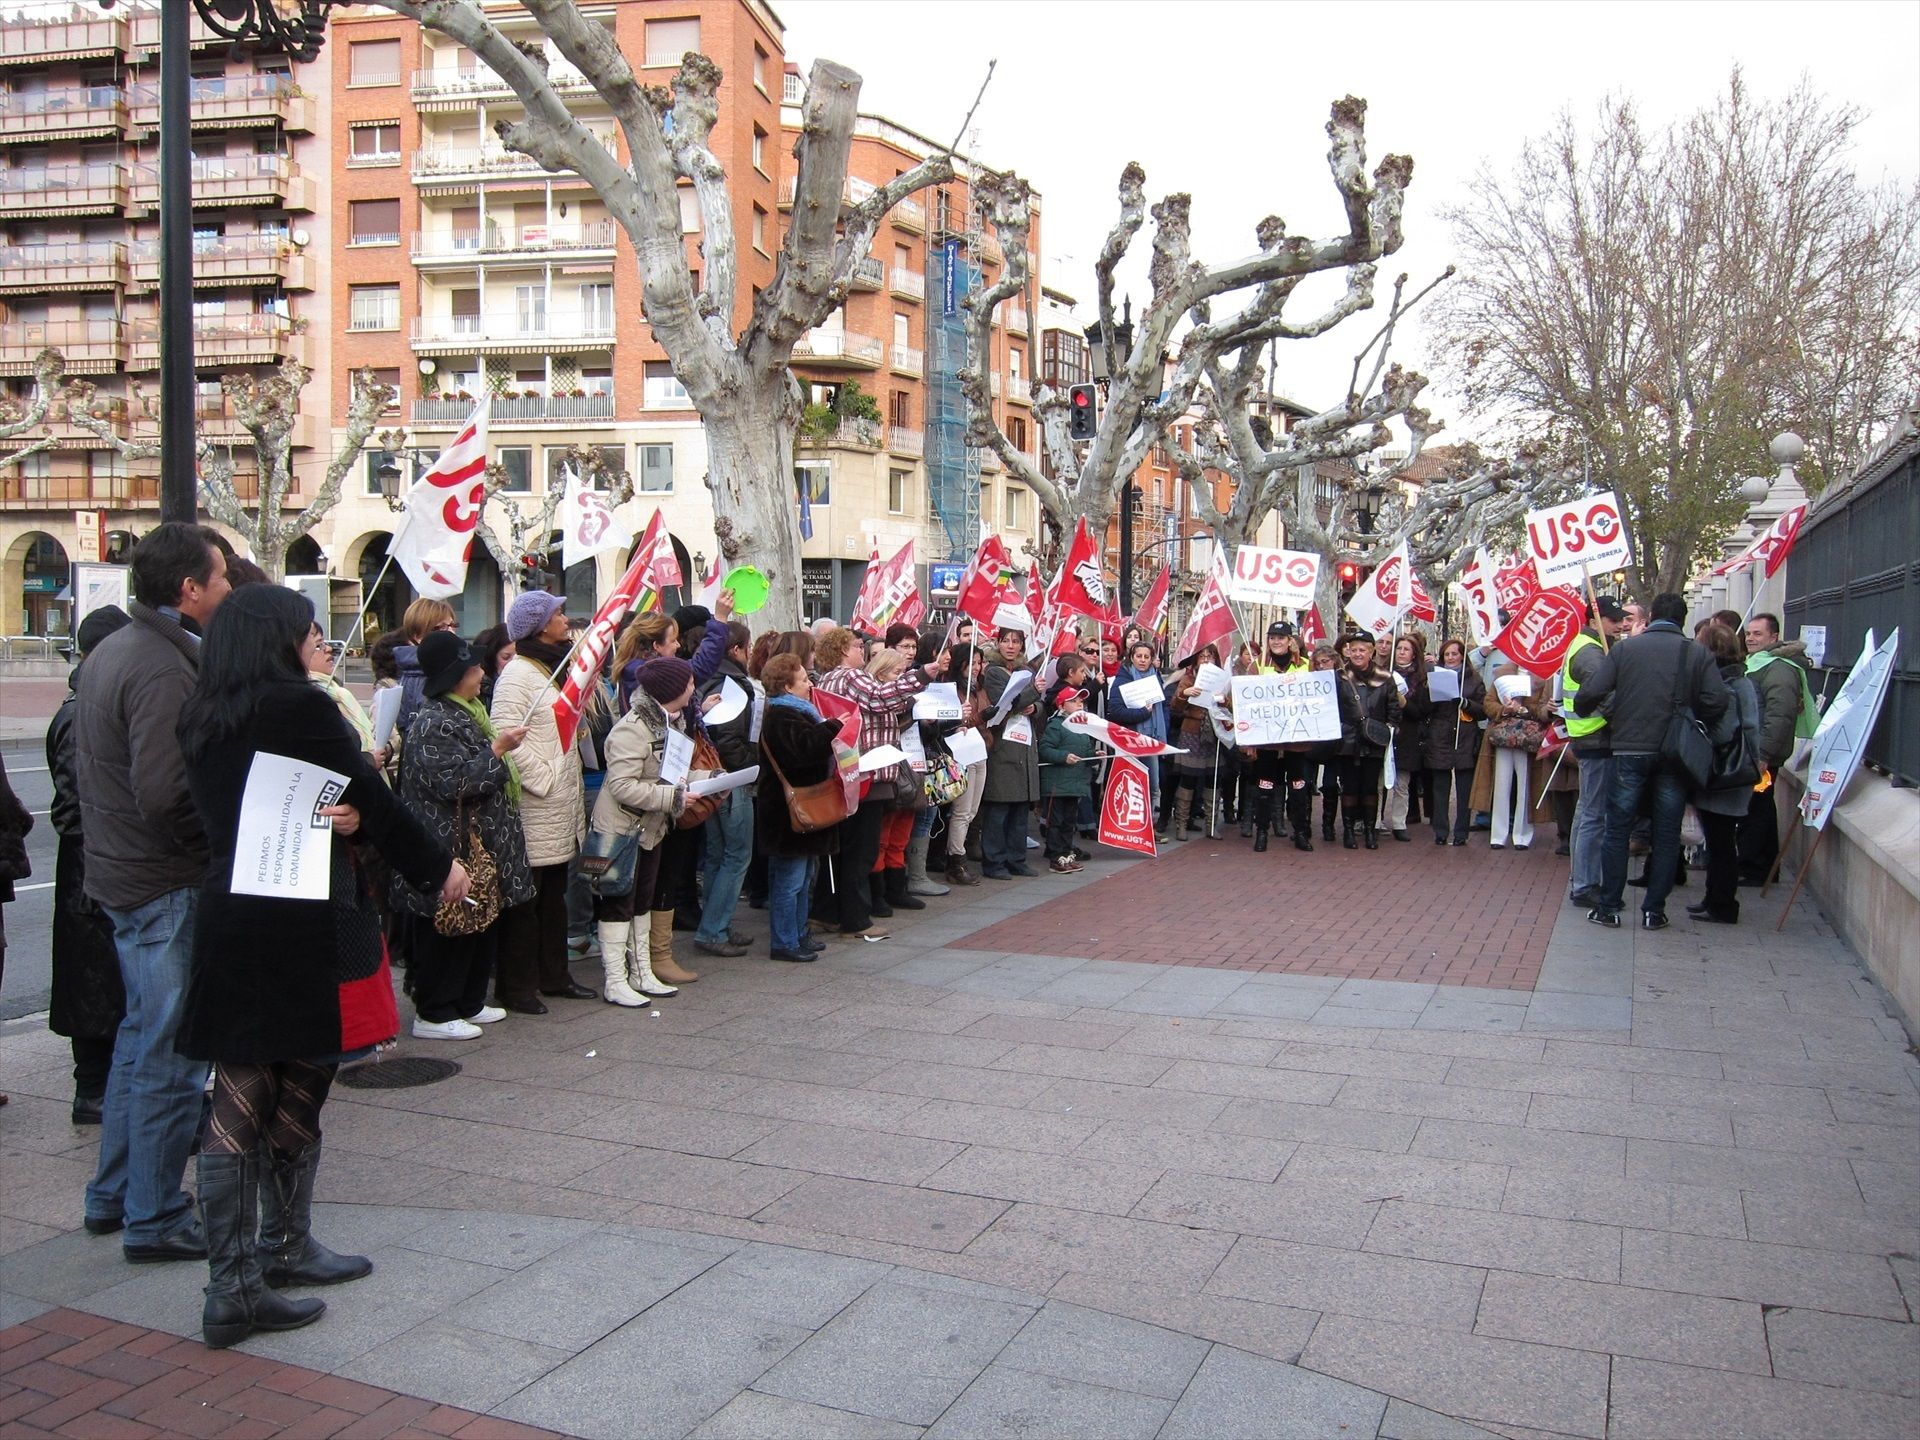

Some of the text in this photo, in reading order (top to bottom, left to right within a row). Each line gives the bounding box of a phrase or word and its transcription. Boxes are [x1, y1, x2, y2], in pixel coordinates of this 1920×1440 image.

[1528, 504, 1619, 560] USO
[1596, 547, 1623, 560] OBRERA
[1236, 551, 1315, 588] USO
[1514, 598, 1558, 647] UGT
[1242, 681, 1332, 699] CONSEJERO
[1129, 780, 1145, 824] UGT
[273, 771, 303, 884] RESPONSABILIDAD A LA
[258, 836, 271, 882] PEDIMOS
[289, 822, 303, 886] COMUNIDAD
